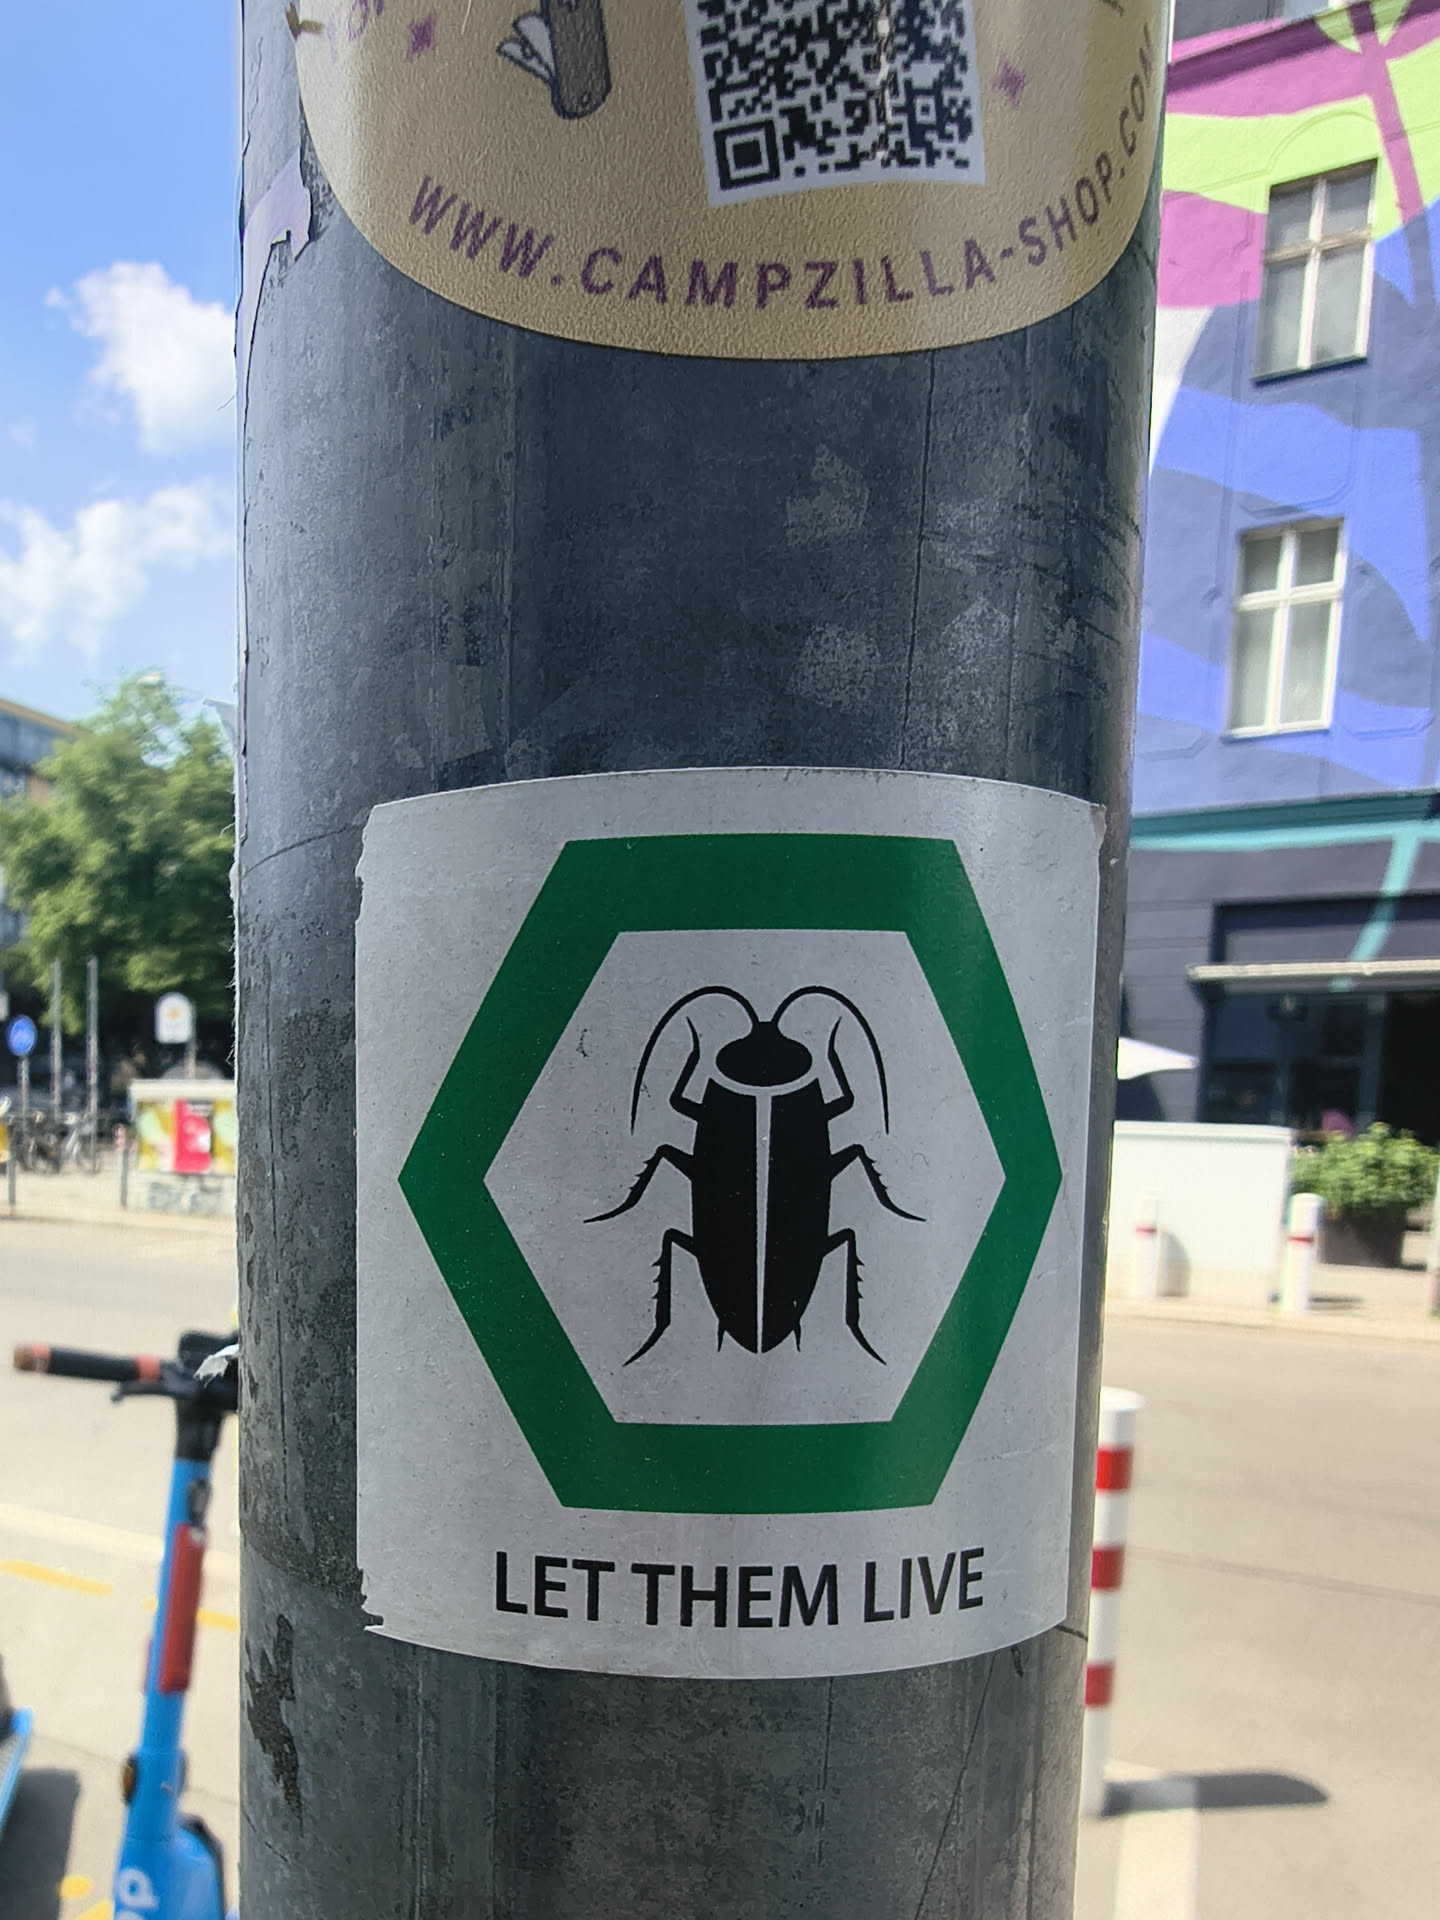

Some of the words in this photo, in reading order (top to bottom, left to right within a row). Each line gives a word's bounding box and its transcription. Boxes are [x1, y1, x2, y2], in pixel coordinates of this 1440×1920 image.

[496, 1551, 615, 1621] LET
[631, 1563, 838, 1628] THEM
[864, 1547, 984, 1623] LIVE
